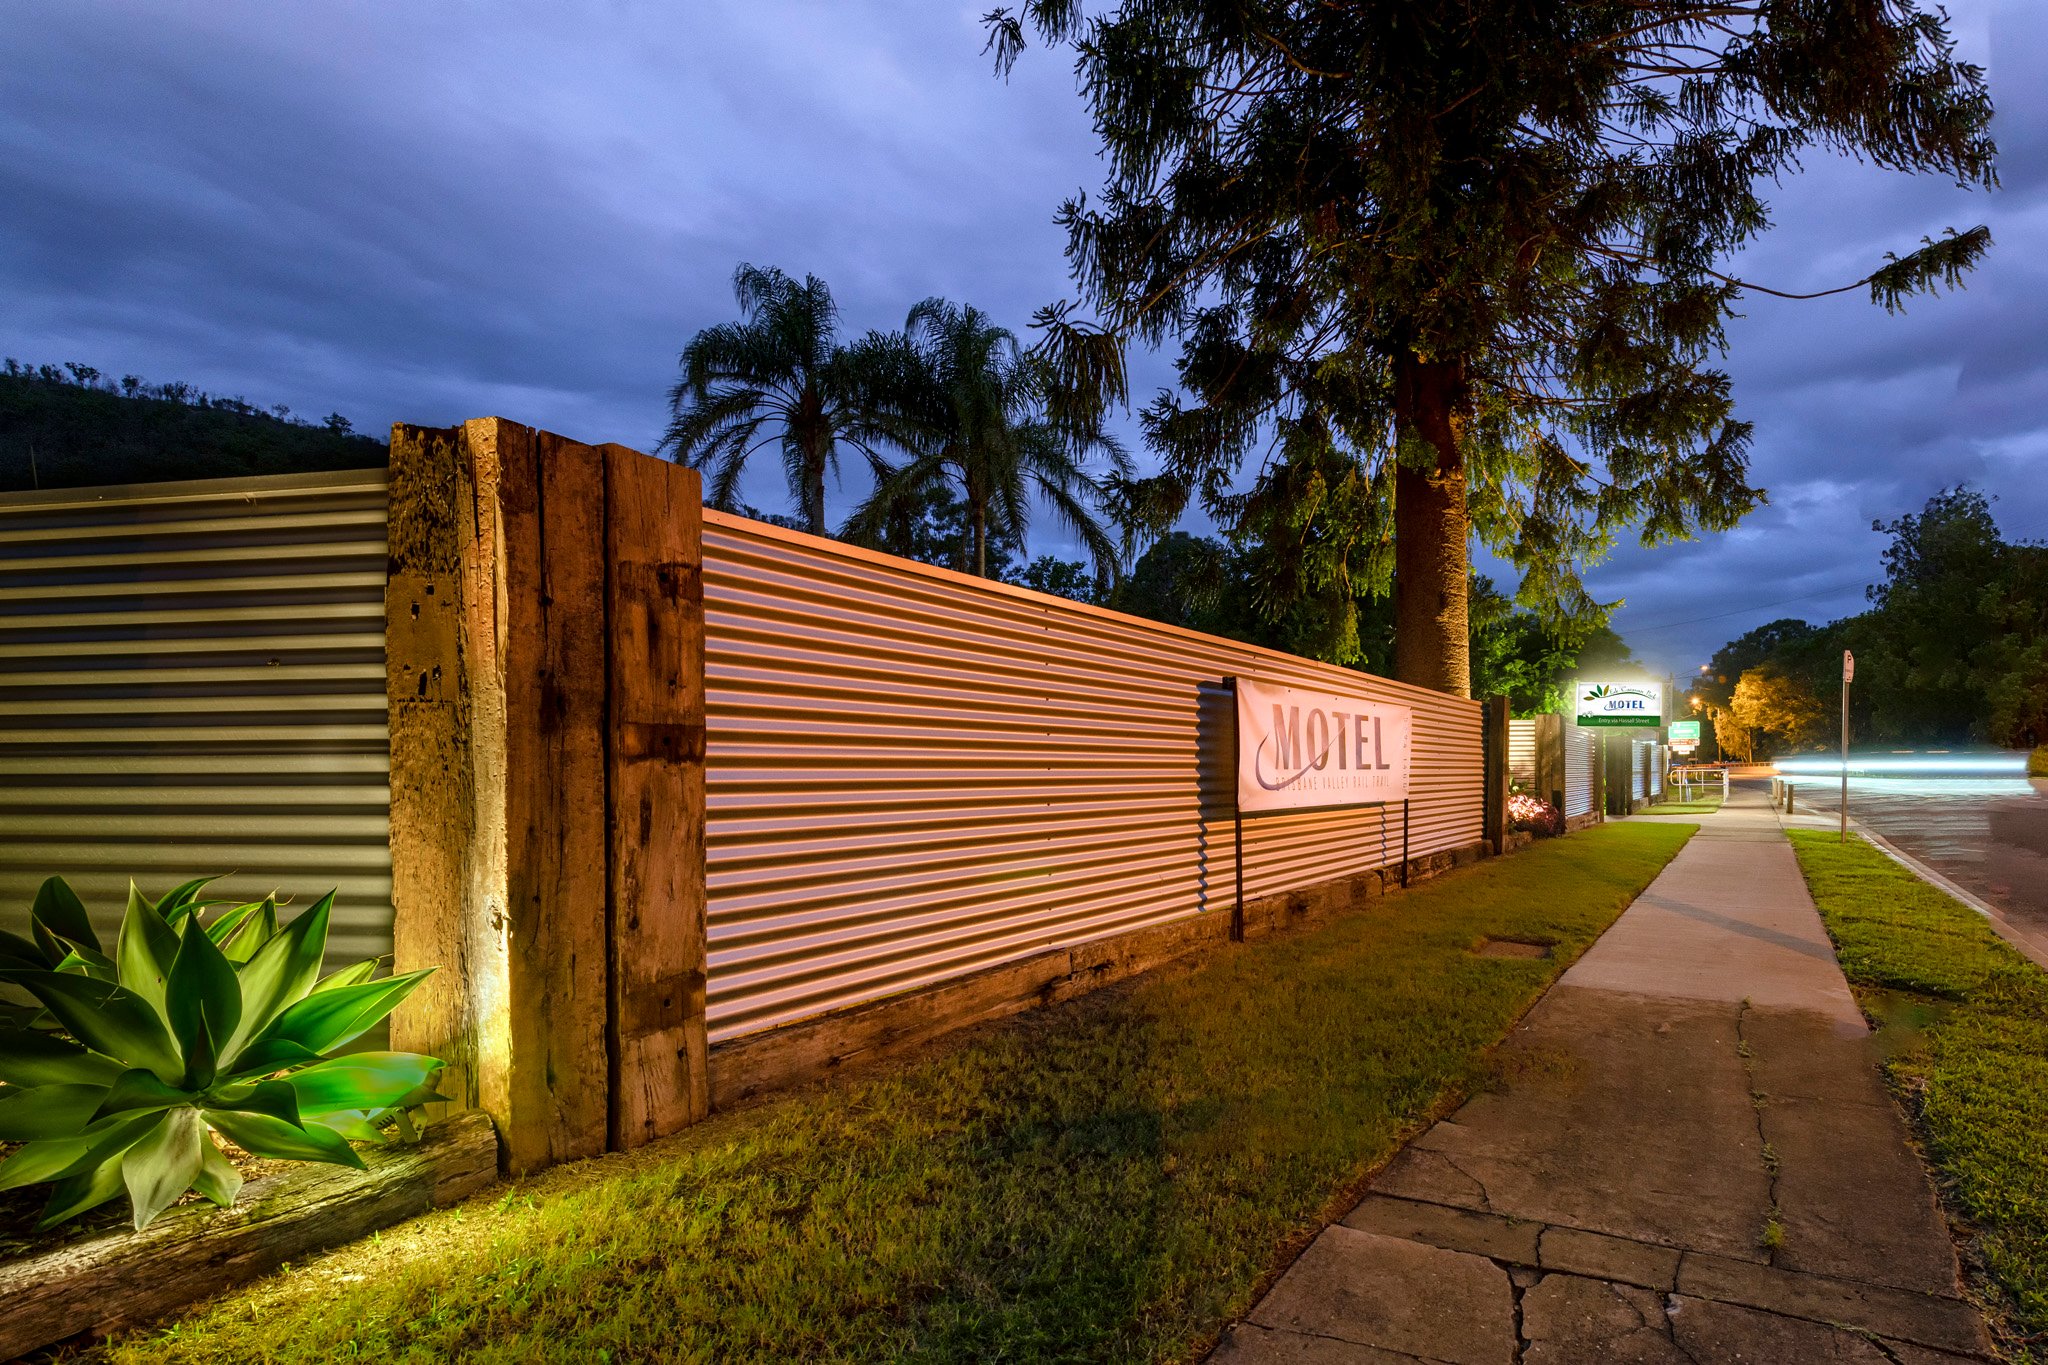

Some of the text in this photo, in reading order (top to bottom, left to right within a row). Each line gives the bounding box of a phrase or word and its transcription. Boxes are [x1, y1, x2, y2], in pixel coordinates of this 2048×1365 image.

[1609, 700, 1645, 709] MOTEL
[1272, 703, 1390, 771] MOTEL
[1322, 774, 1349, 789] VALLEY
[1353, 774, 1368, 788] RAIL
[1372, 774, 1390, 787] TRAIL
